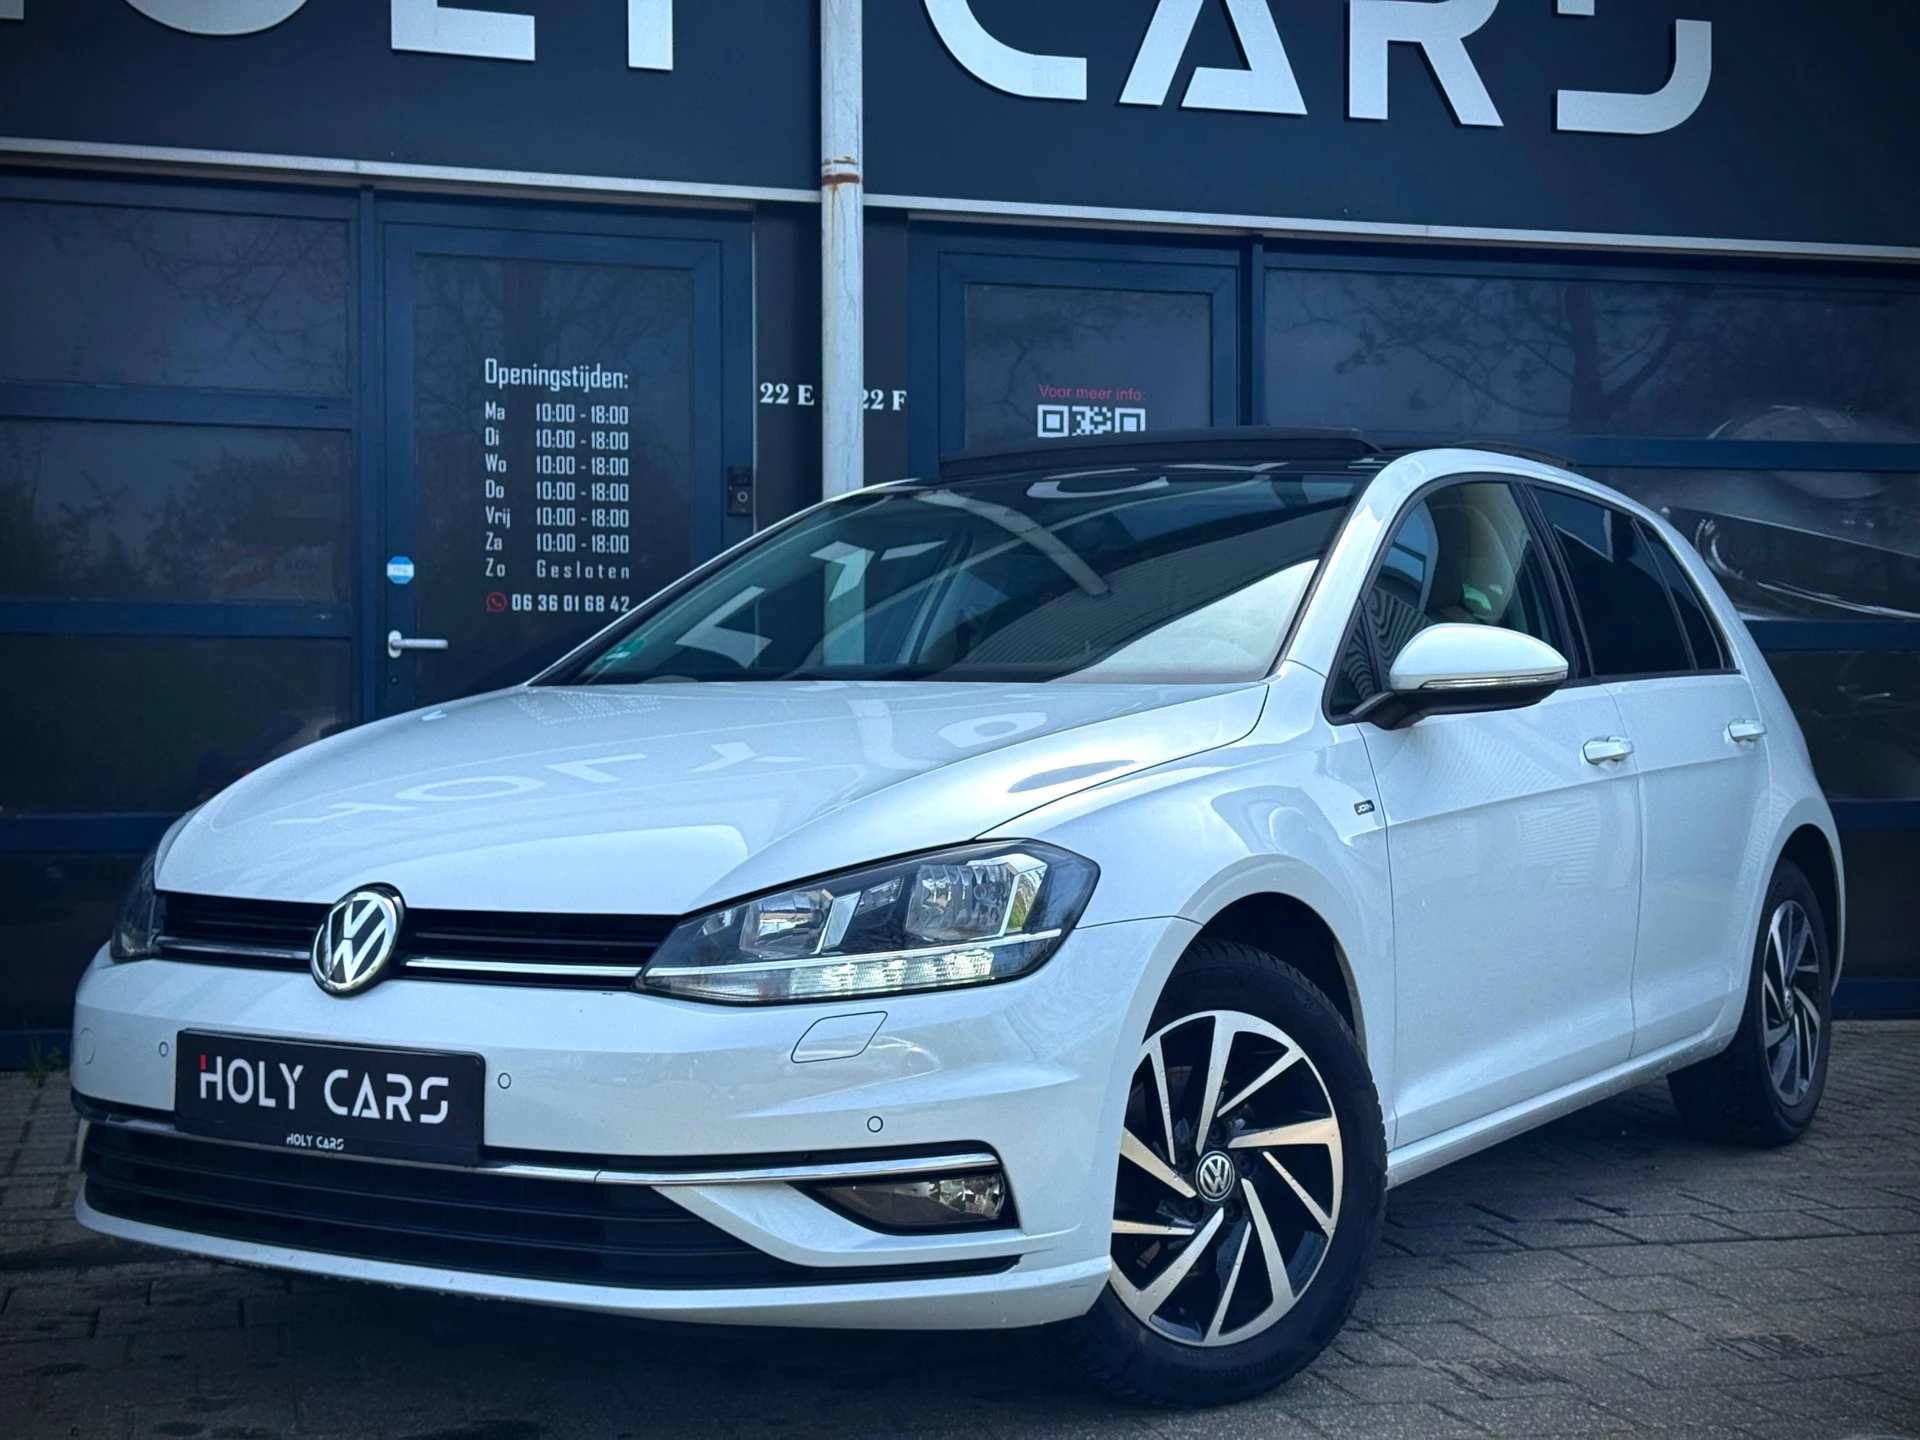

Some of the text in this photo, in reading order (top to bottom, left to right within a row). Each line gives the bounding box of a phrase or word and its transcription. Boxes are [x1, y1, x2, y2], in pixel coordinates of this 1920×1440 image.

[484, 357, 629, 393] Openingstijden:
[759, 382, 815, 406] 22 E
[892, 390, 907, 411] F
[1038, 384, 1146, 401] Voor meer info:
[485, 401, 505, 420] Ma
[536, 403, 575, 423] 10:00
[591, 405, 629, 425] 18:00
[485, 426, 500, 446] Di
[536, 429, 576, 449] 10:00
[591, 431, 629, 450] 18:00
[485, 453, 507, 473] Wo
[536, 455, 576, 475] 10:00
[591, 456, 629, 476] 18:00
[485, 479, 505, 499] Do
[536, 481, 576, 501] 10:00
[591, 482, 629, 502] 18:00
[485, 505, 511, 529] Vrij
[536, 506, 576, 527] 10:00
[591, 508, 629, 528] 18:00
[485, 531, 503, 551] Za
[536, 533, 576, 552] 10:00
[591, 534, 629, 554] 18:00
[485, 557, 630, 579] Zo Gesloten
[512, 593, 632, 613] 06 36 01 68 42
[200, 1054, 449, 1125] HOLY CARS
[286, 1132, 345, 1151] HOLY CARS
